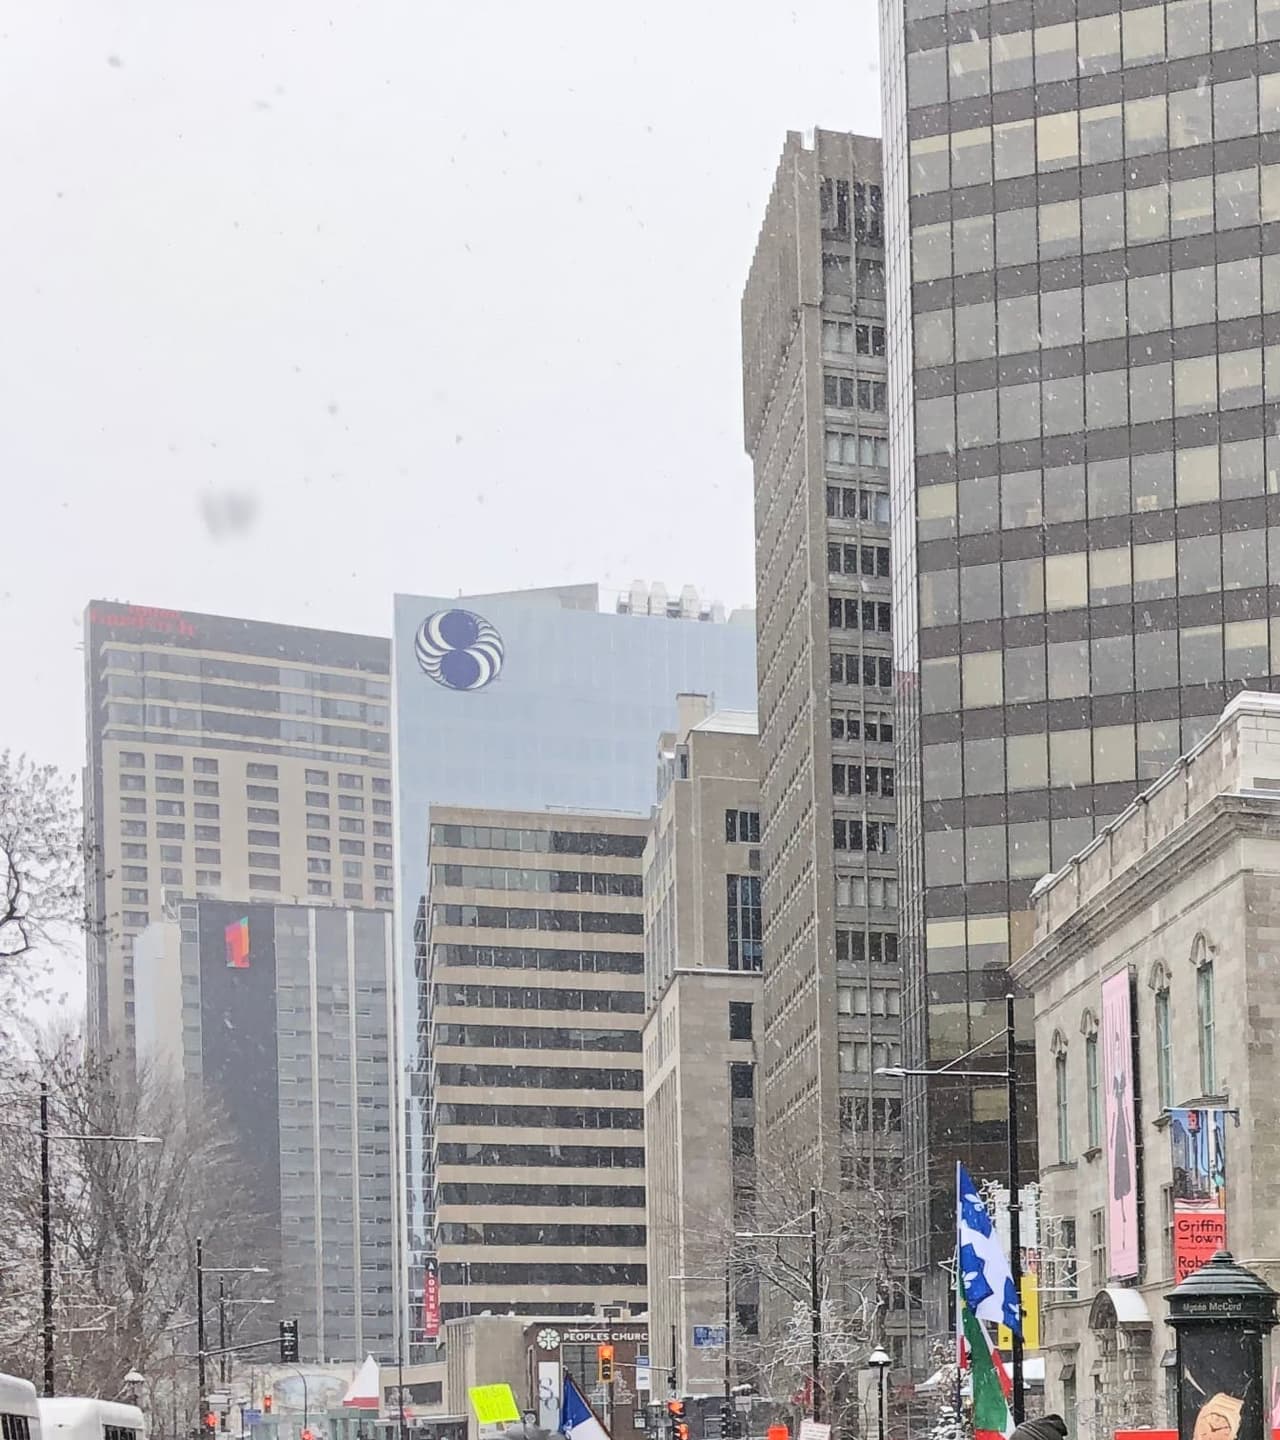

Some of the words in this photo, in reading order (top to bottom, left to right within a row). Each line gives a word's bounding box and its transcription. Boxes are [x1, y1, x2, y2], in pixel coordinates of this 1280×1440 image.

[1177, 1219, 1224, 1233] Griffin
[1208, 1301, 1242, 1311] McCord
[563, 1332, 610, 1342] PEOPLES
[611, 1332, 649, 1341] CHURC
